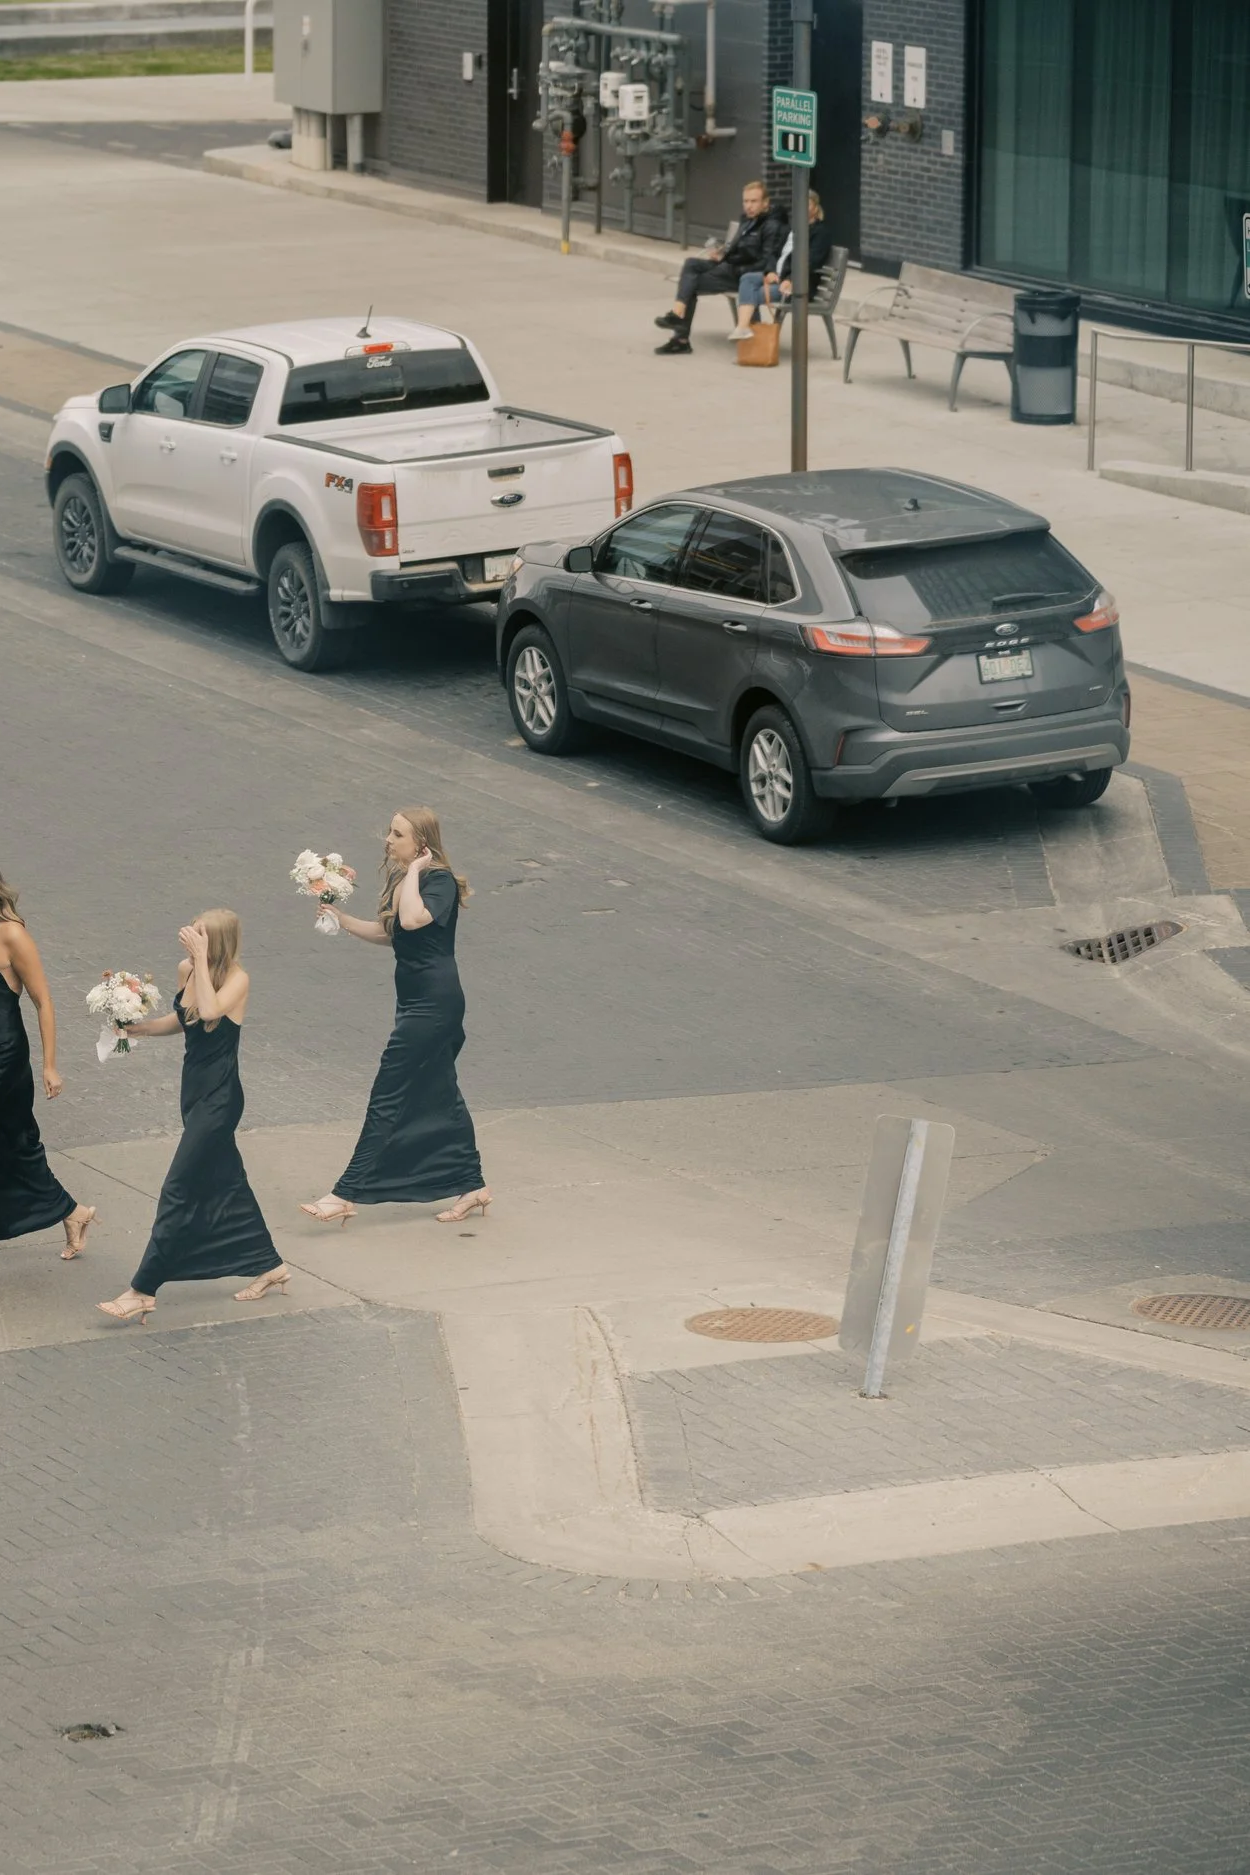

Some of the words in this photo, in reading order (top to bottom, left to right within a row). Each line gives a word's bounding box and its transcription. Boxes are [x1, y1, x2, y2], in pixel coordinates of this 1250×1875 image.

[776, 96, 812, 112] PARALLEL
[777, 110, 811, 126] PARKING
[366, 355, 392, 369] Ford
[325, 472, 353, 493] FX4
